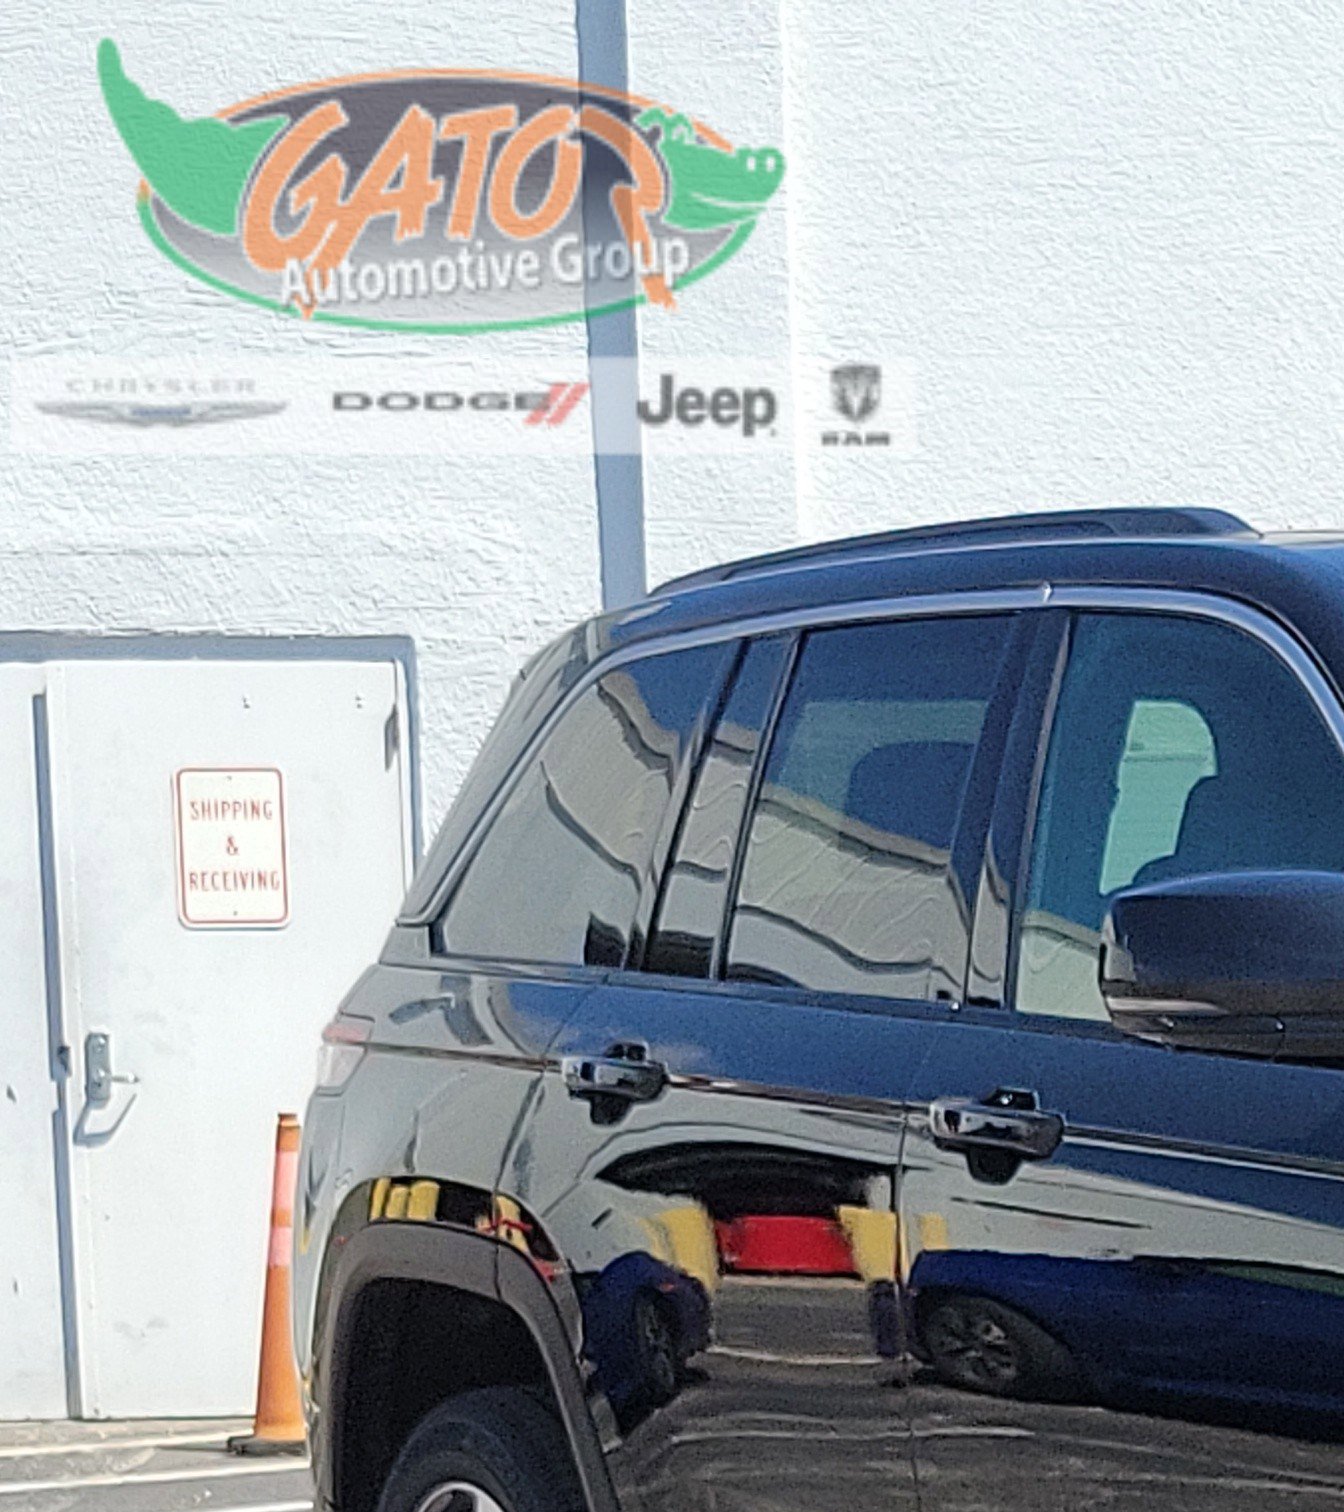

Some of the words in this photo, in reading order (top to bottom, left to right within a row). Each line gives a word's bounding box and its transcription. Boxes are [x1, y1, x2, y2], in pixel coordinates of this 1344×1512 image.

[190, 800, 273, 821] SHIPPING
[226, 835, 240, 856] &
[189, 871, 280, 892] RECEIVING
